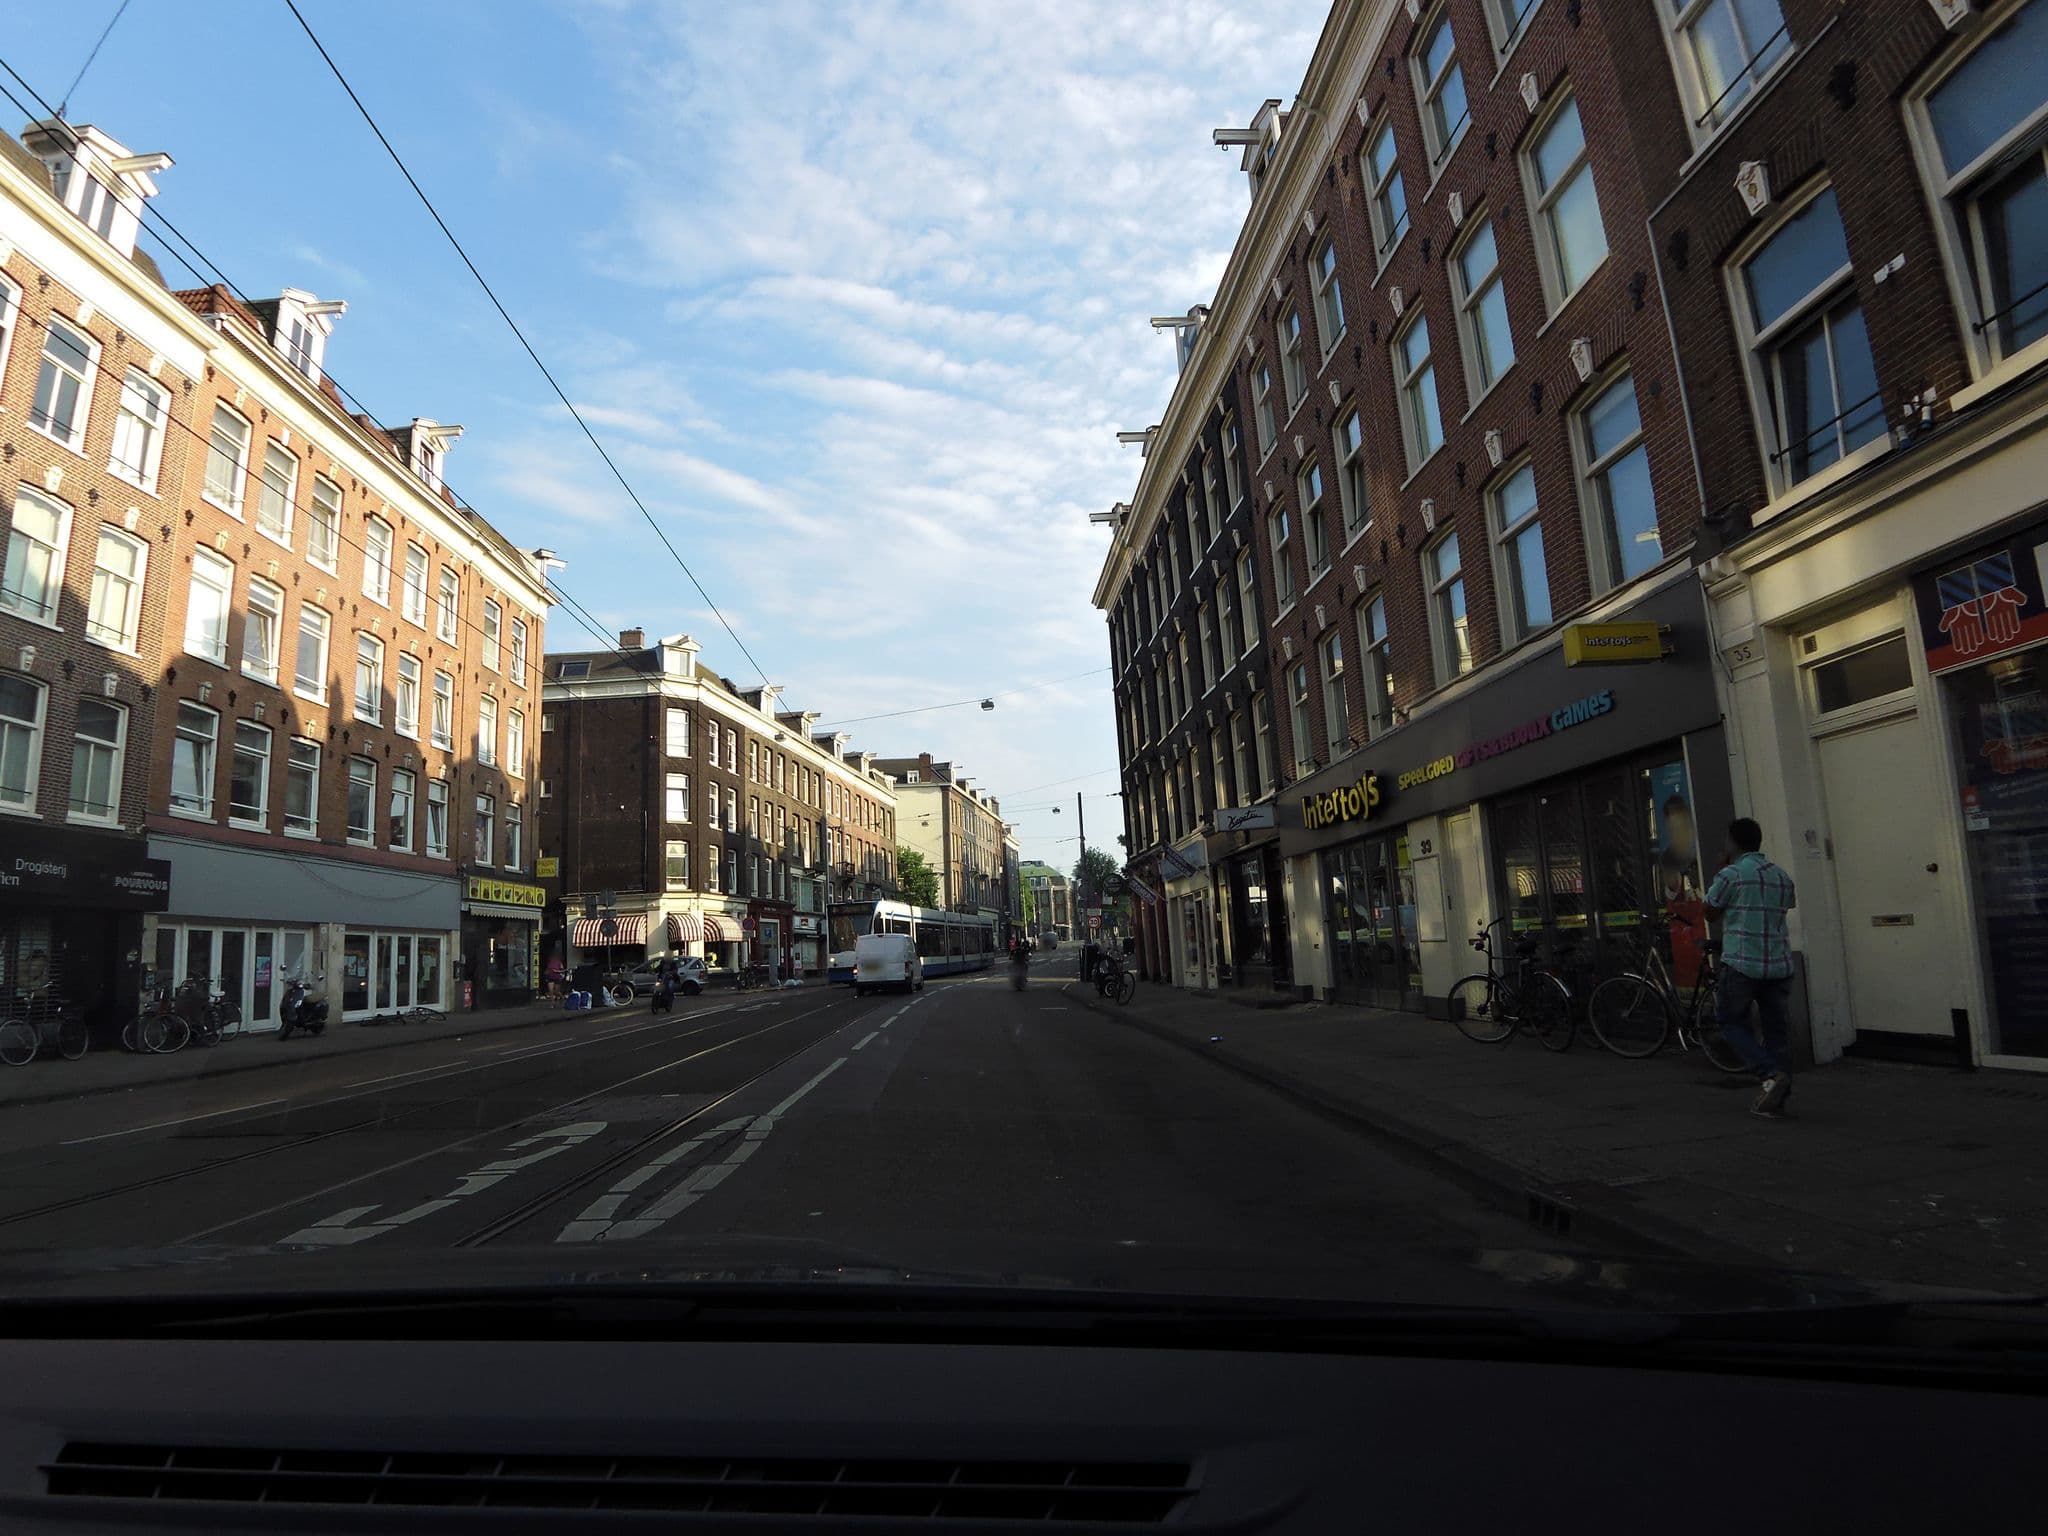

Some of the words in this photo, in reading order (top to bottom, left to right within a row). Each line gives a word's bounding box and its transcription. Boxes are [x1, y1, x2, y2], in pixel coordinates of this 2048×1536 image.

[1733, 646, 1752, 662] 35
[1301, 772, 1381, 829] Intertoys
[15, 858, 68, 878] Drogisterij
